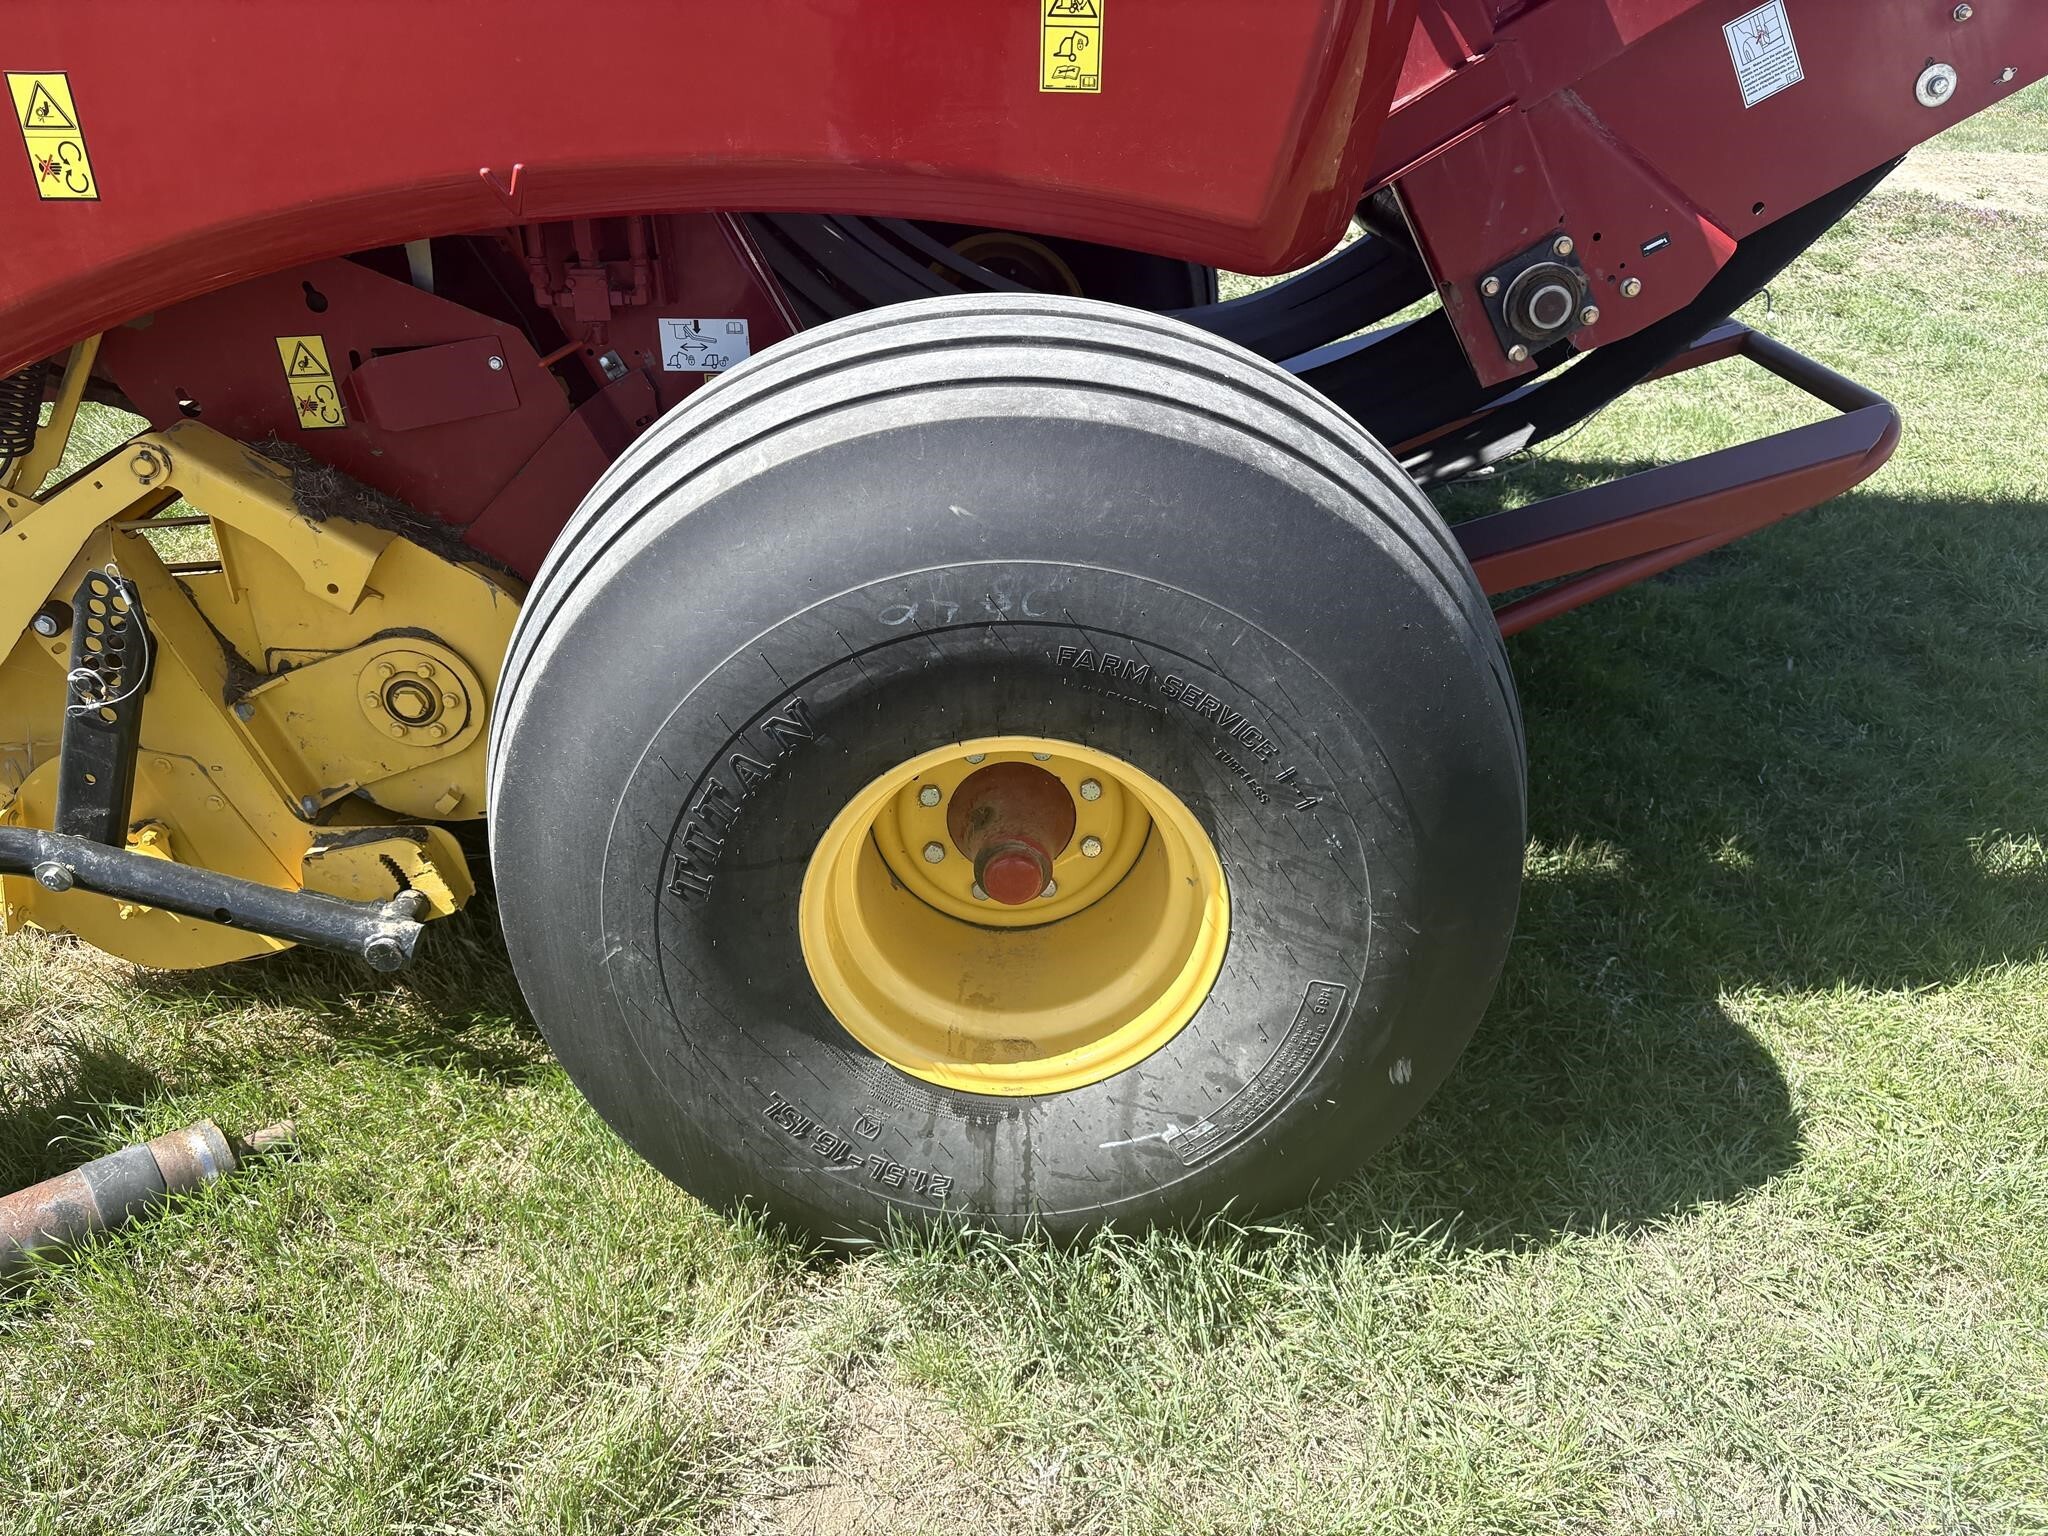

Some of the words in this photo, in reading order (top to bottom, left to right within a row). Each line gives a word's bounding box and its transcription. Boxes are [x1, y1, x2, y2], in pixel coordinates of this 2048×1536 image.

[1056, 645, 1150, 685] FARM
[1160, 674, 1278, 762] SERVICE
[1215, 749, 1270, 805] TUBELESS
[667, 697, 814, 902] TITAN
[1296, 1029, 1312, 1050] RATED
[1284, 1049, 1300, 1068] LOAD
[1288, 1047, 1312, 1076] RATING
[1253, 1082, 1285, 1113] STUBBLE
[1229, 1109, 1256, 1132] GUARD
[763, 1091, 953, 1197] 21.5L-16.1SL
